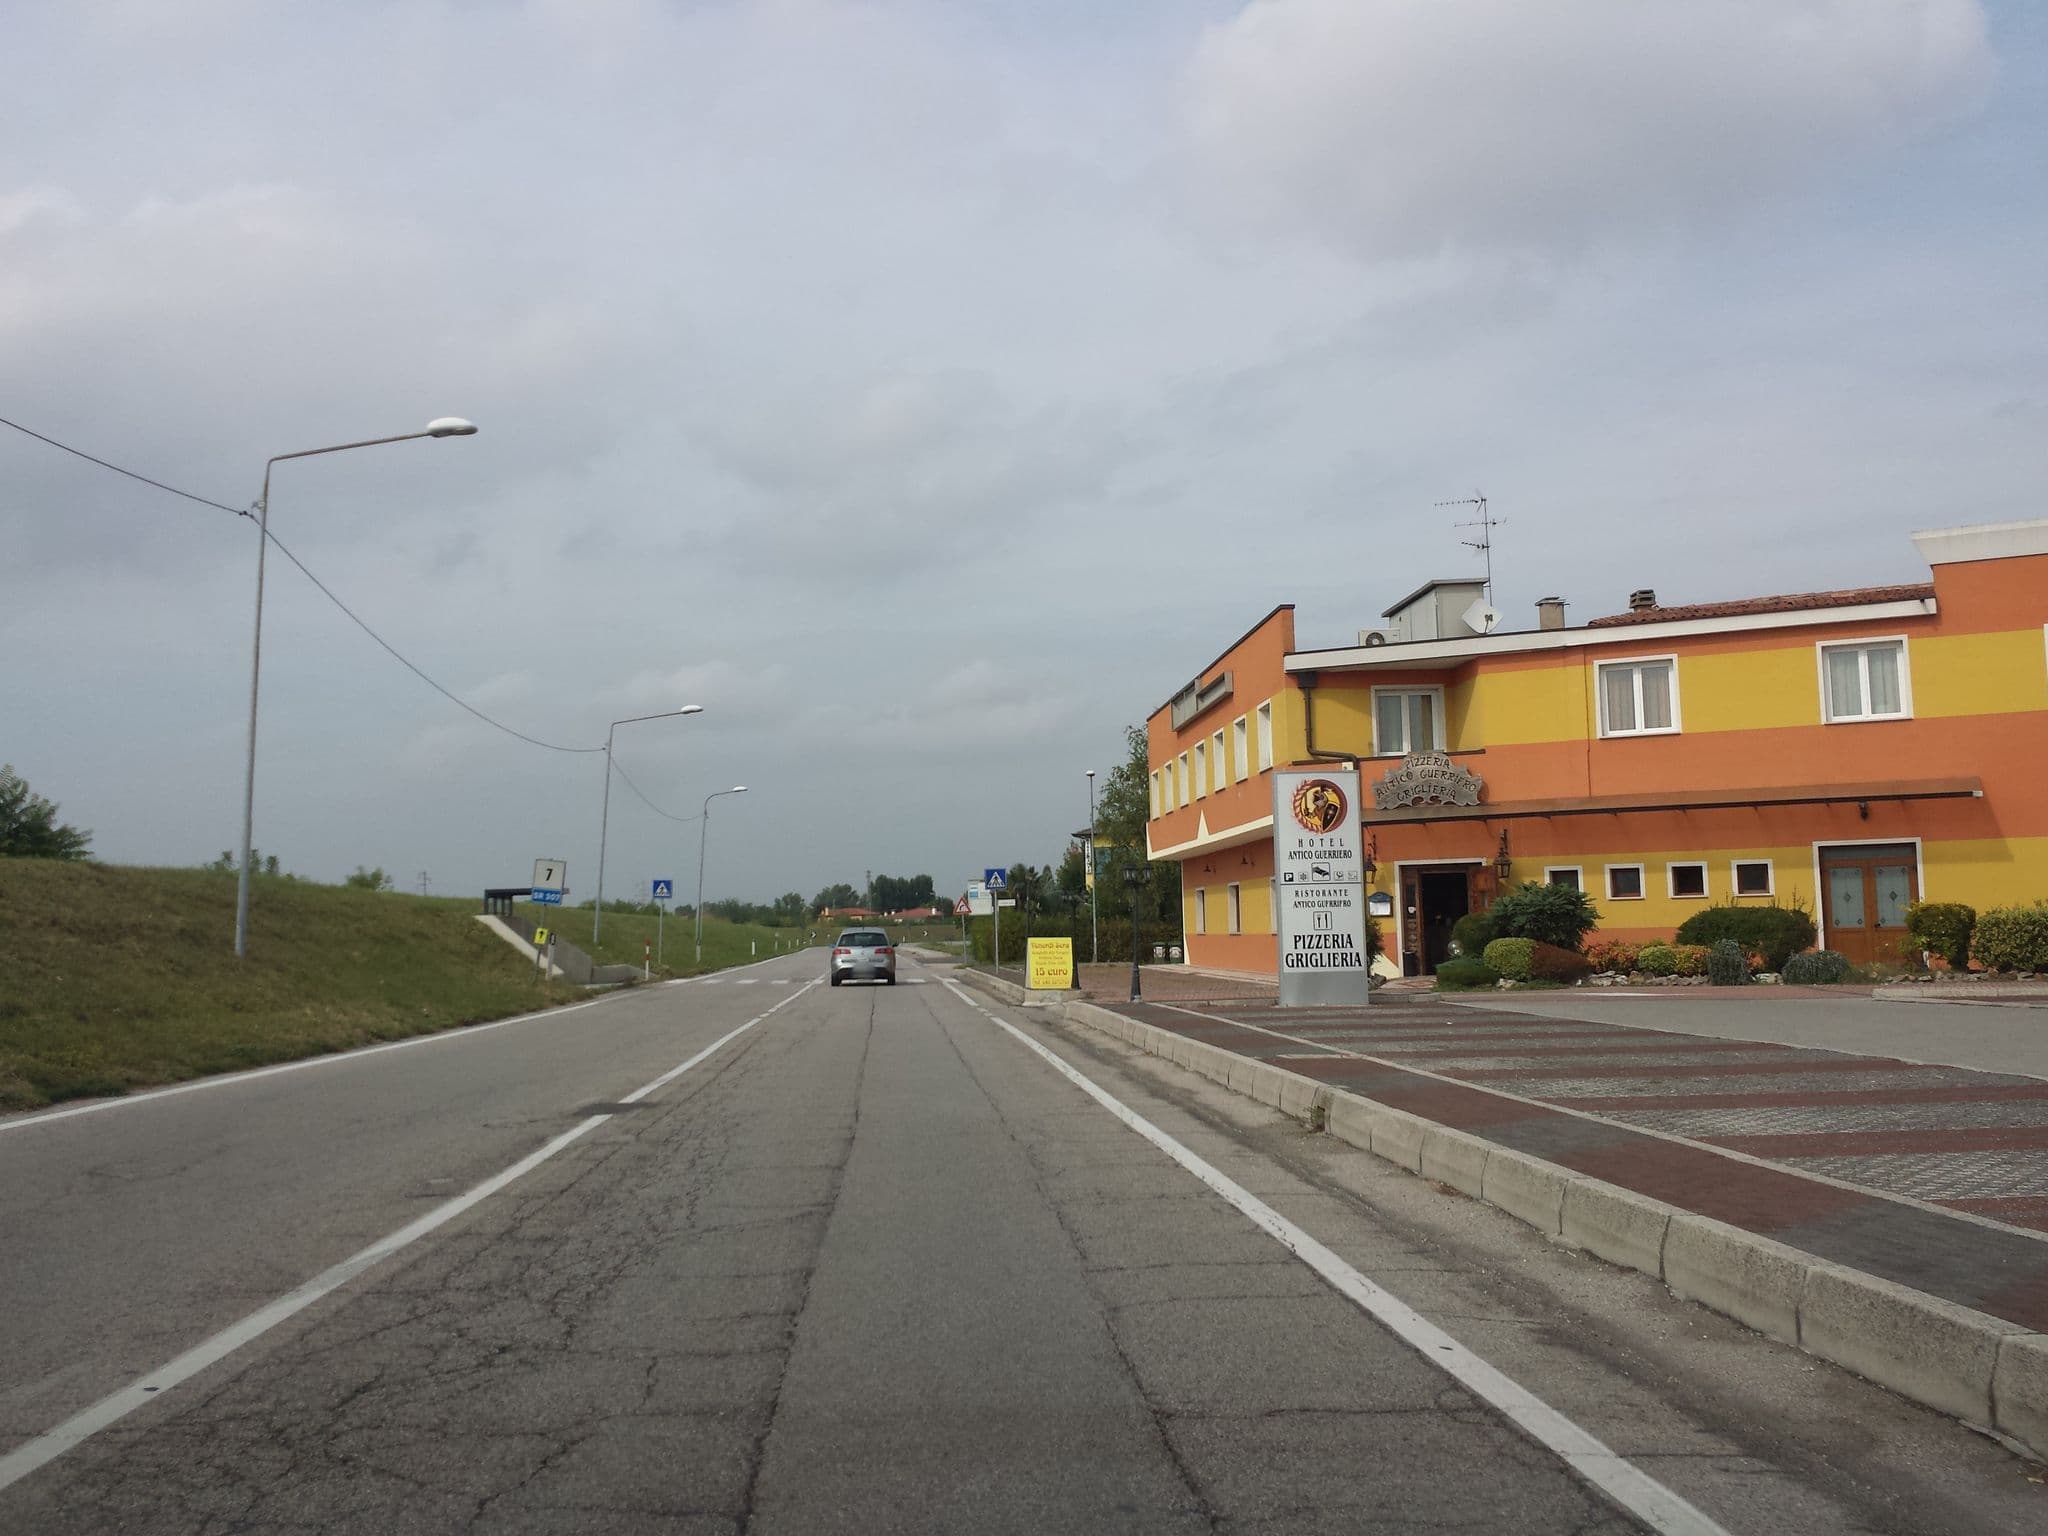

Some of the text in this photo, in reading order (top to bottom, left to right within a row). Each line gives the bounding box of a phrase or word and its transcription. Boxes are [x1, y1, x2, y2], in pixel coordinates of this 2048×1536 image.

[1406, 757, 1450, 769] PIZZERIA
[1376, 771, 1413, 798] ANTICO
[1397, 783, 1456, 800] GRIGLIERIA
[1288, 850, 1352, 860] ANTICO GUERRIERO
[545, 868, 553, 881] 7
[1295, 889, 1349, 898] RISTORANTE
[1293, 901, 1316, 909] ANTICO
[1294, 934, 1353, 949] PIZZERIA
[1285, 952, 1362, 968] GRIGLIERIA
[1036, 968, 1046, 976] 15
